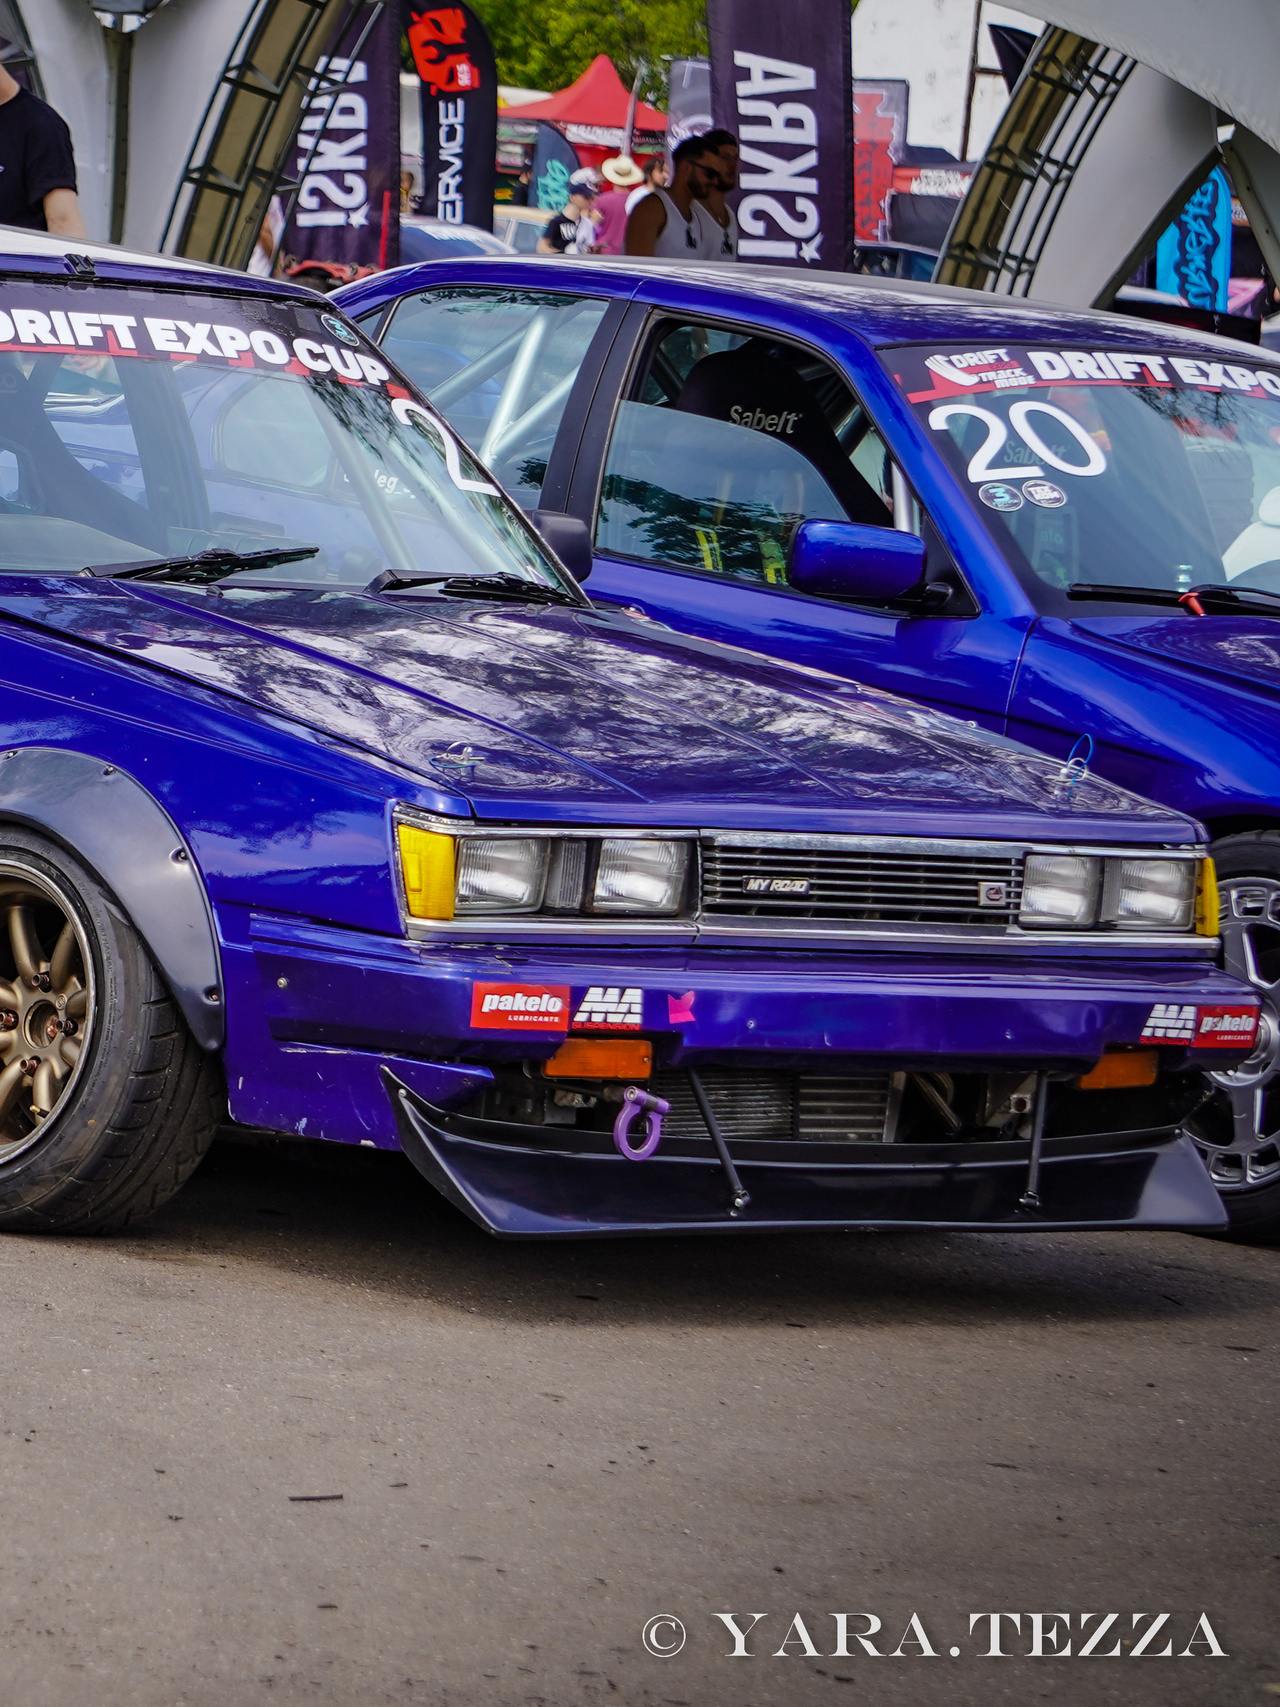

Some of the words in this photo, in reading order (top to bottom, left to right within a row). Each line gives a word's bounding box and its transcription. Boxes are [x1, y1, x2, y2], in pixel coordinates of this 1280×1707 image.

[437, 97, 465, 224] ERVICE
[143, 317, 290, 365] EXPO
[292, 338, 390, 386] CUP
[949, 348, 1011, 369] DRIFT
[978, 367, 1028, 382] TRACK
[1026, 352, 1170, 382] DRIFT
[1169, 357, 1280, 393] EXPO
[730, 405, 798, 434] Sabelt
[391, 398, 502, 497] 2
[928, 400, 1107, 483] 20
[1003, 440, 1067, 465] Sabt
[746, 878, 771, 891] MY
[769, 879, 809, 892] ROAD
[481, 993, 563, 1013] pakelo
[571, 1021, 641, 1031] SUSPENSION
[1199, 1014, 1256, 1034] pakelo
